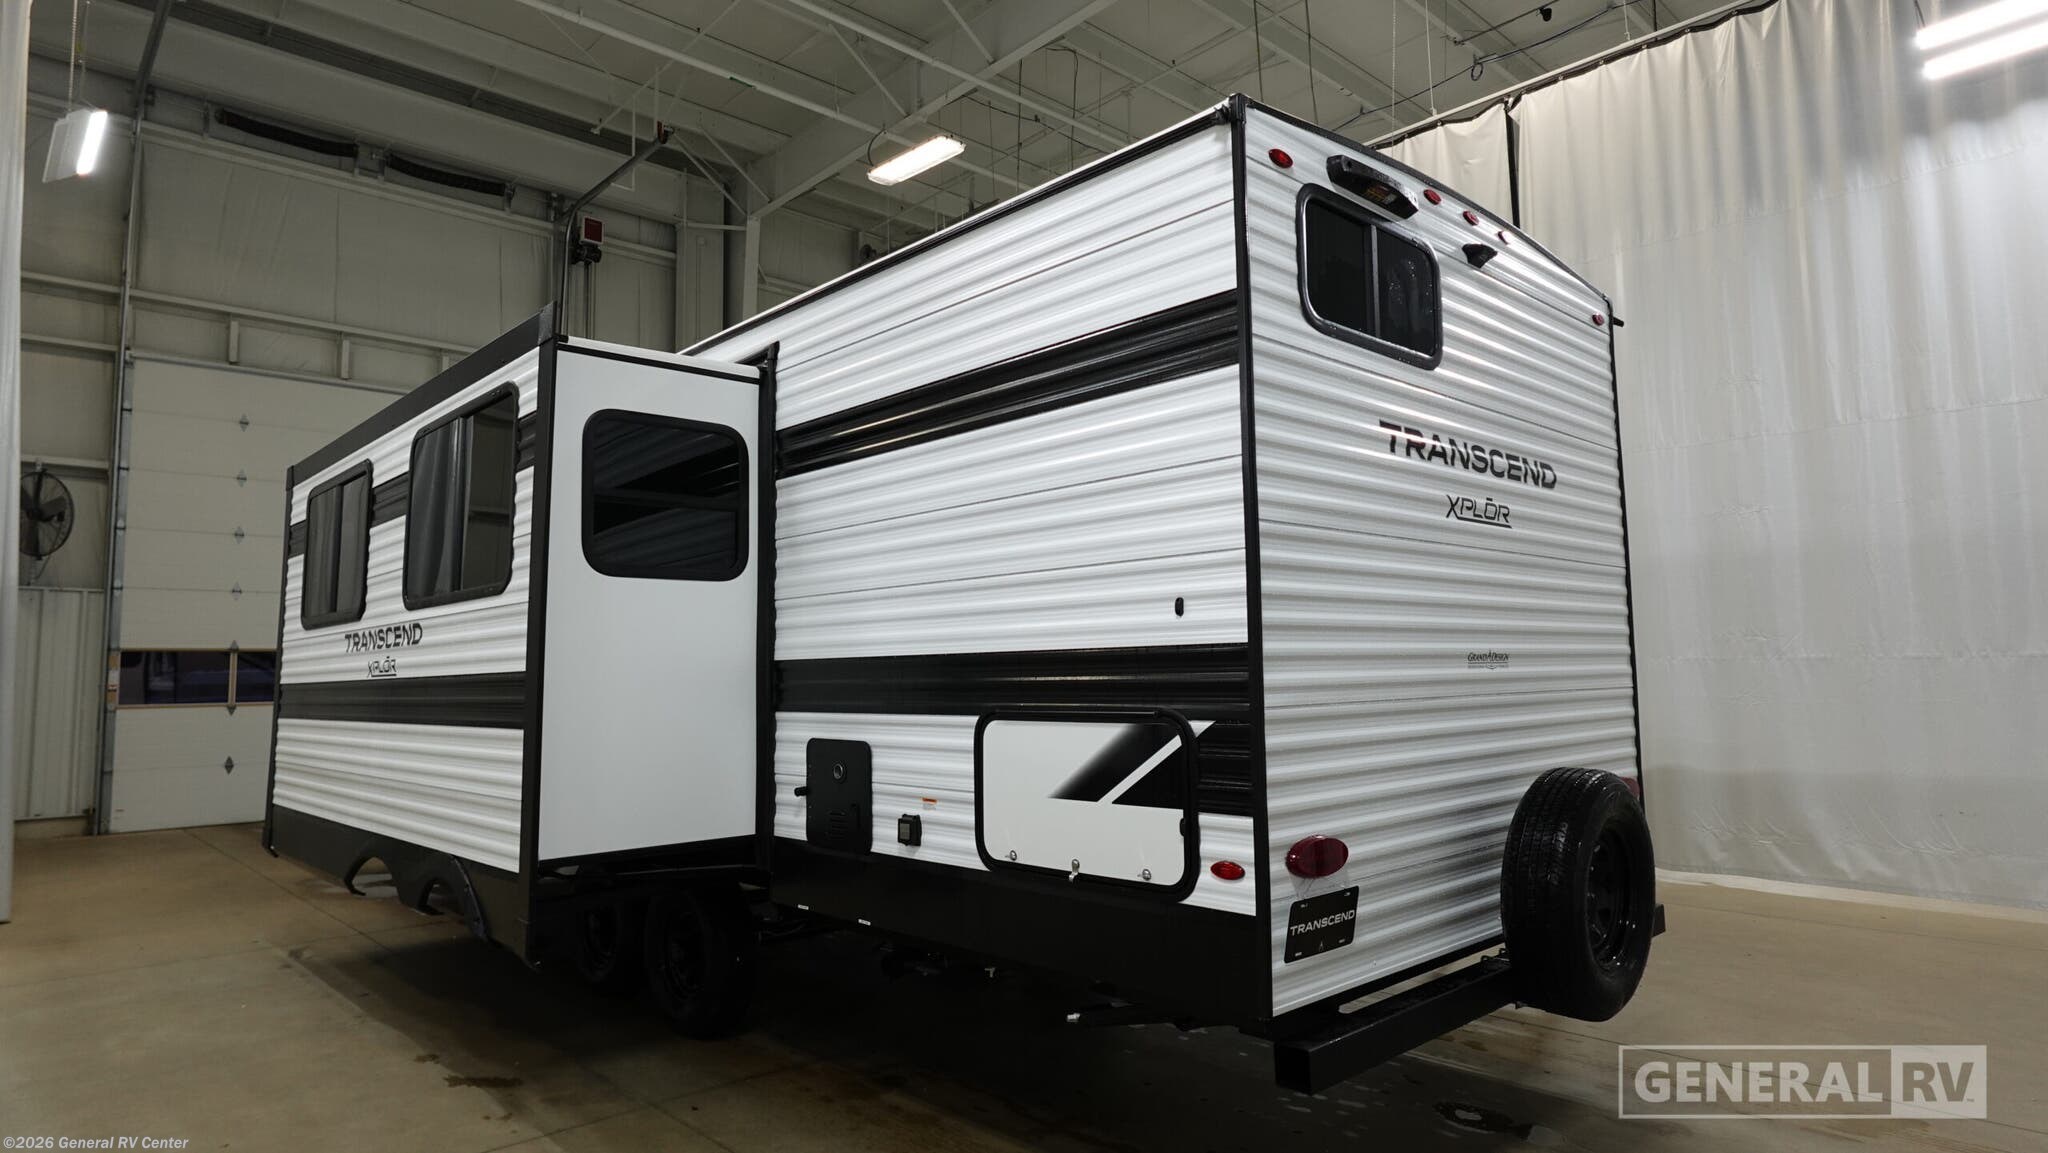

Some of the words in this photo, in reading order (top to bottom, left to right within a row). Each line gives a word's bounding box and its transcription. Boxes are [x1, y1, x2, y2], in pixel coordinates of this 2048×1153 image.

[1379, 419, 1558, 490] TRANSCEND
[344, 622, 423, 653] TRANSCEND
[1290, 909, 1356, 936] TRANSCEND
